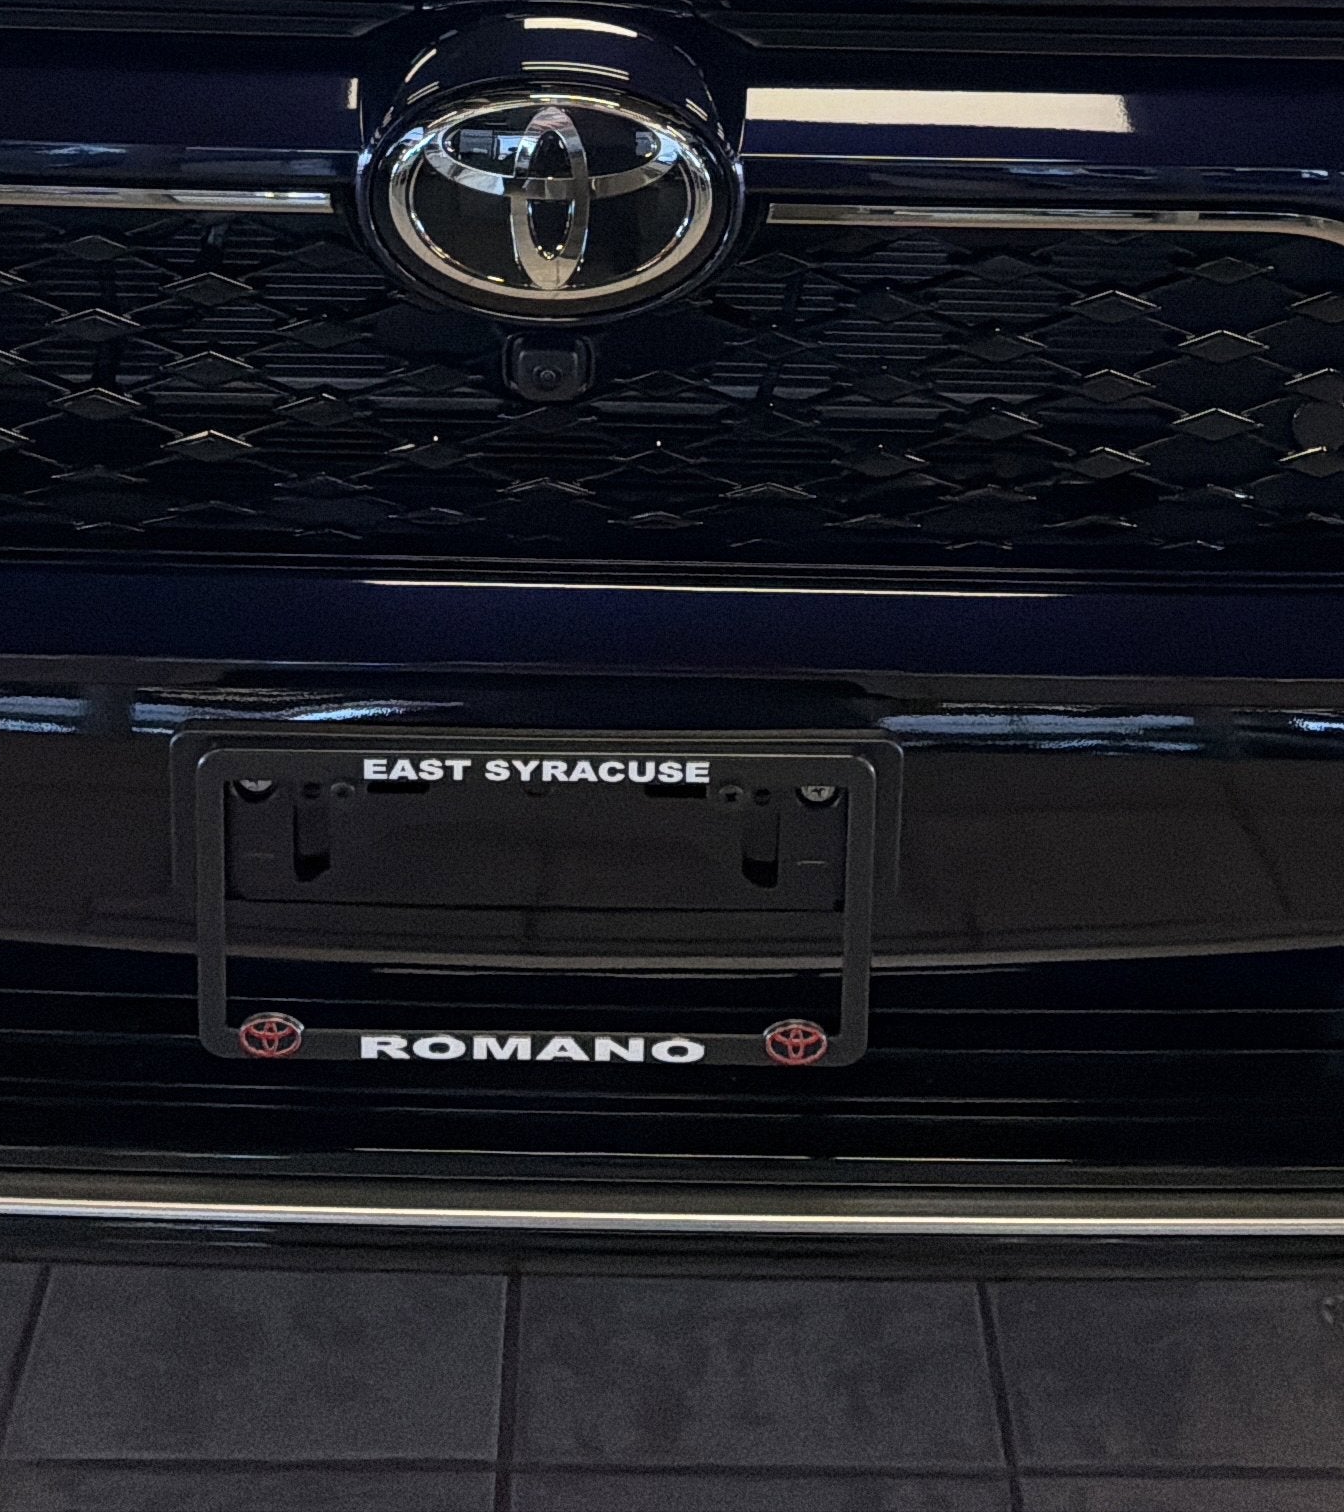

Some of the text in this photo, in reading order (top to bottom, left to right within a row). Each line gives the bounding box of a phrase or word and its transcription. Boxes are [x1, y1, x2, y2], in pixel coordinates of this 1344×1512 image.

[362, 758, 711, 784] EAST SYRACUSE
[359, 1035, 706, 1064] ROMANO
